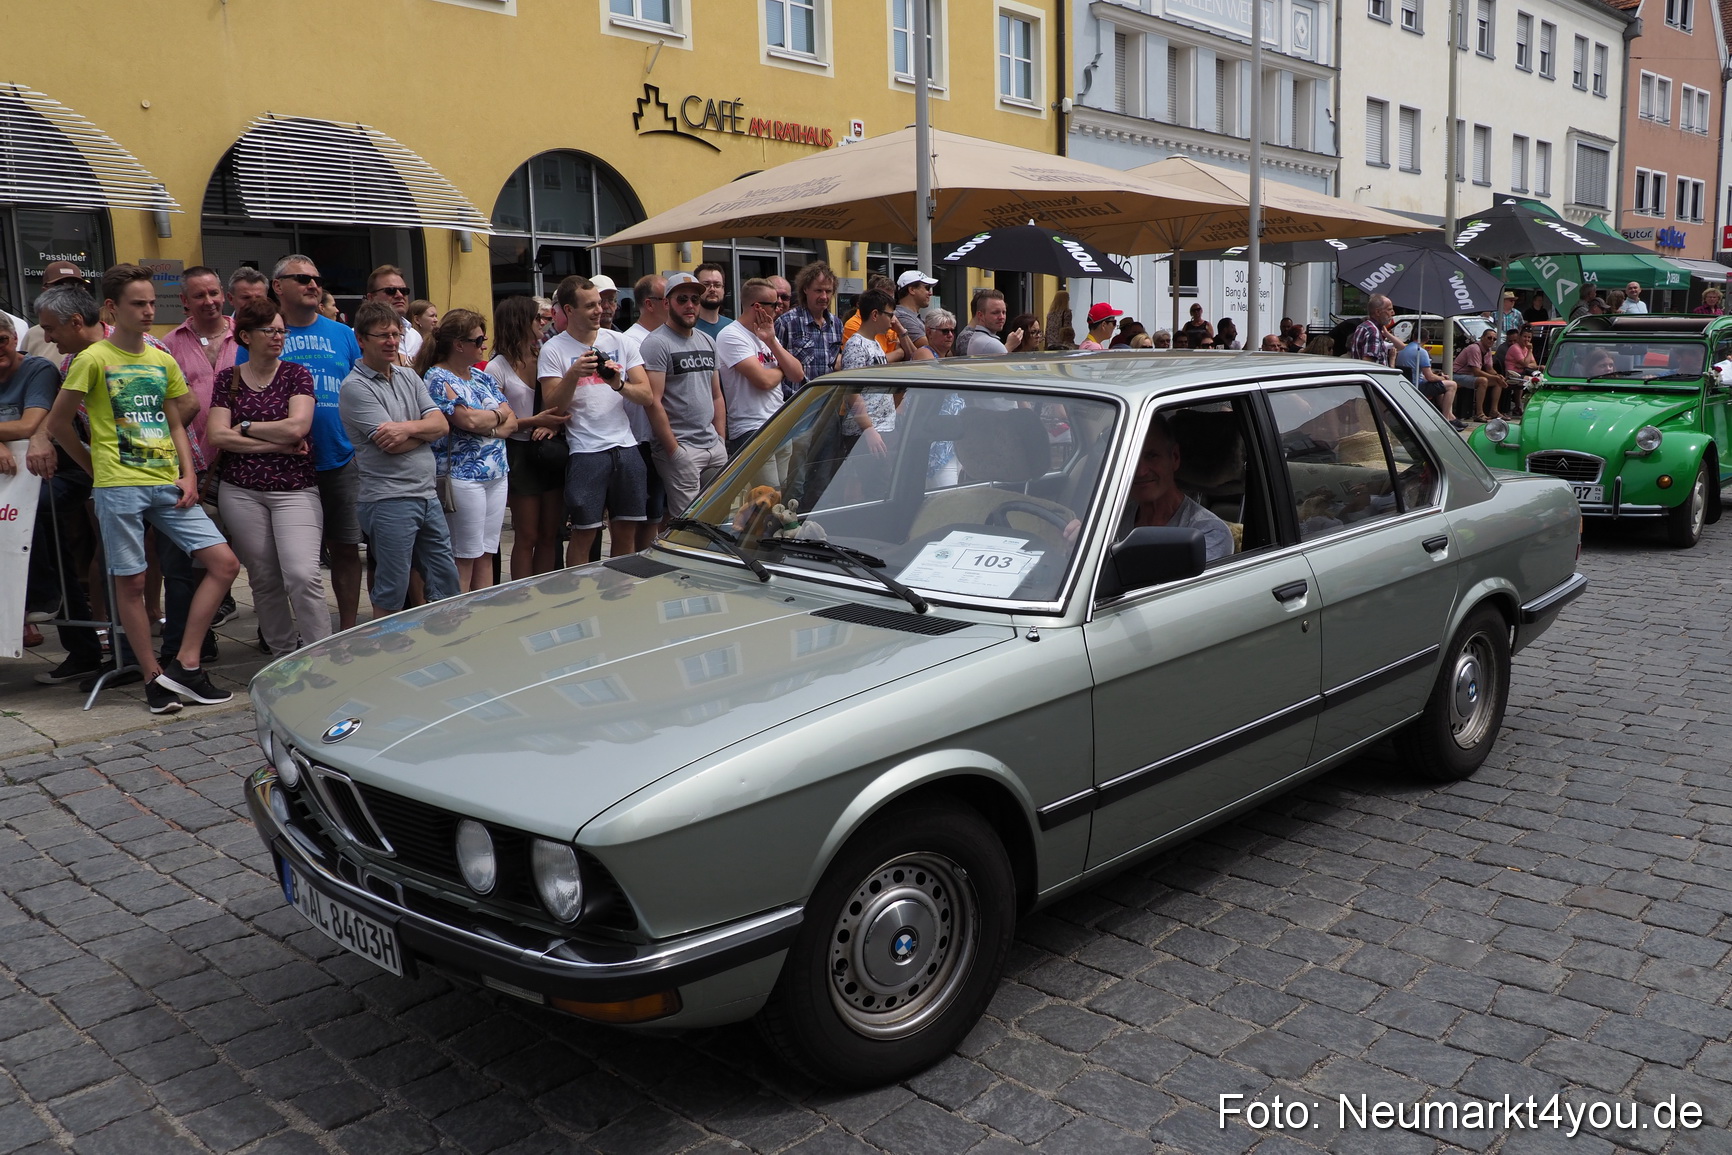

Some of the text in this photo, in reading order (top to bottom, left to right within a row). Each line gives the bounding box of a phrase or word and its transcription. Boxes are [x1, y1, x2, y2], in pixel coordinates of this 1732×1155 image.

[681, 95, 834, 147] CAFÉ AM RATHAUS
[39, 252, 87, 262] Passbilder
[1235, 270, 1244, 283] 30
[1226, 286, 1241, 299] Bang
[134, 395, 158, 406] CITY
[124, 411, 153, 423] STATE
[974, 554, 1014, 569] 103
[309, 885, 329, 931] AL
[330, 902, 398, 969] 8403H
